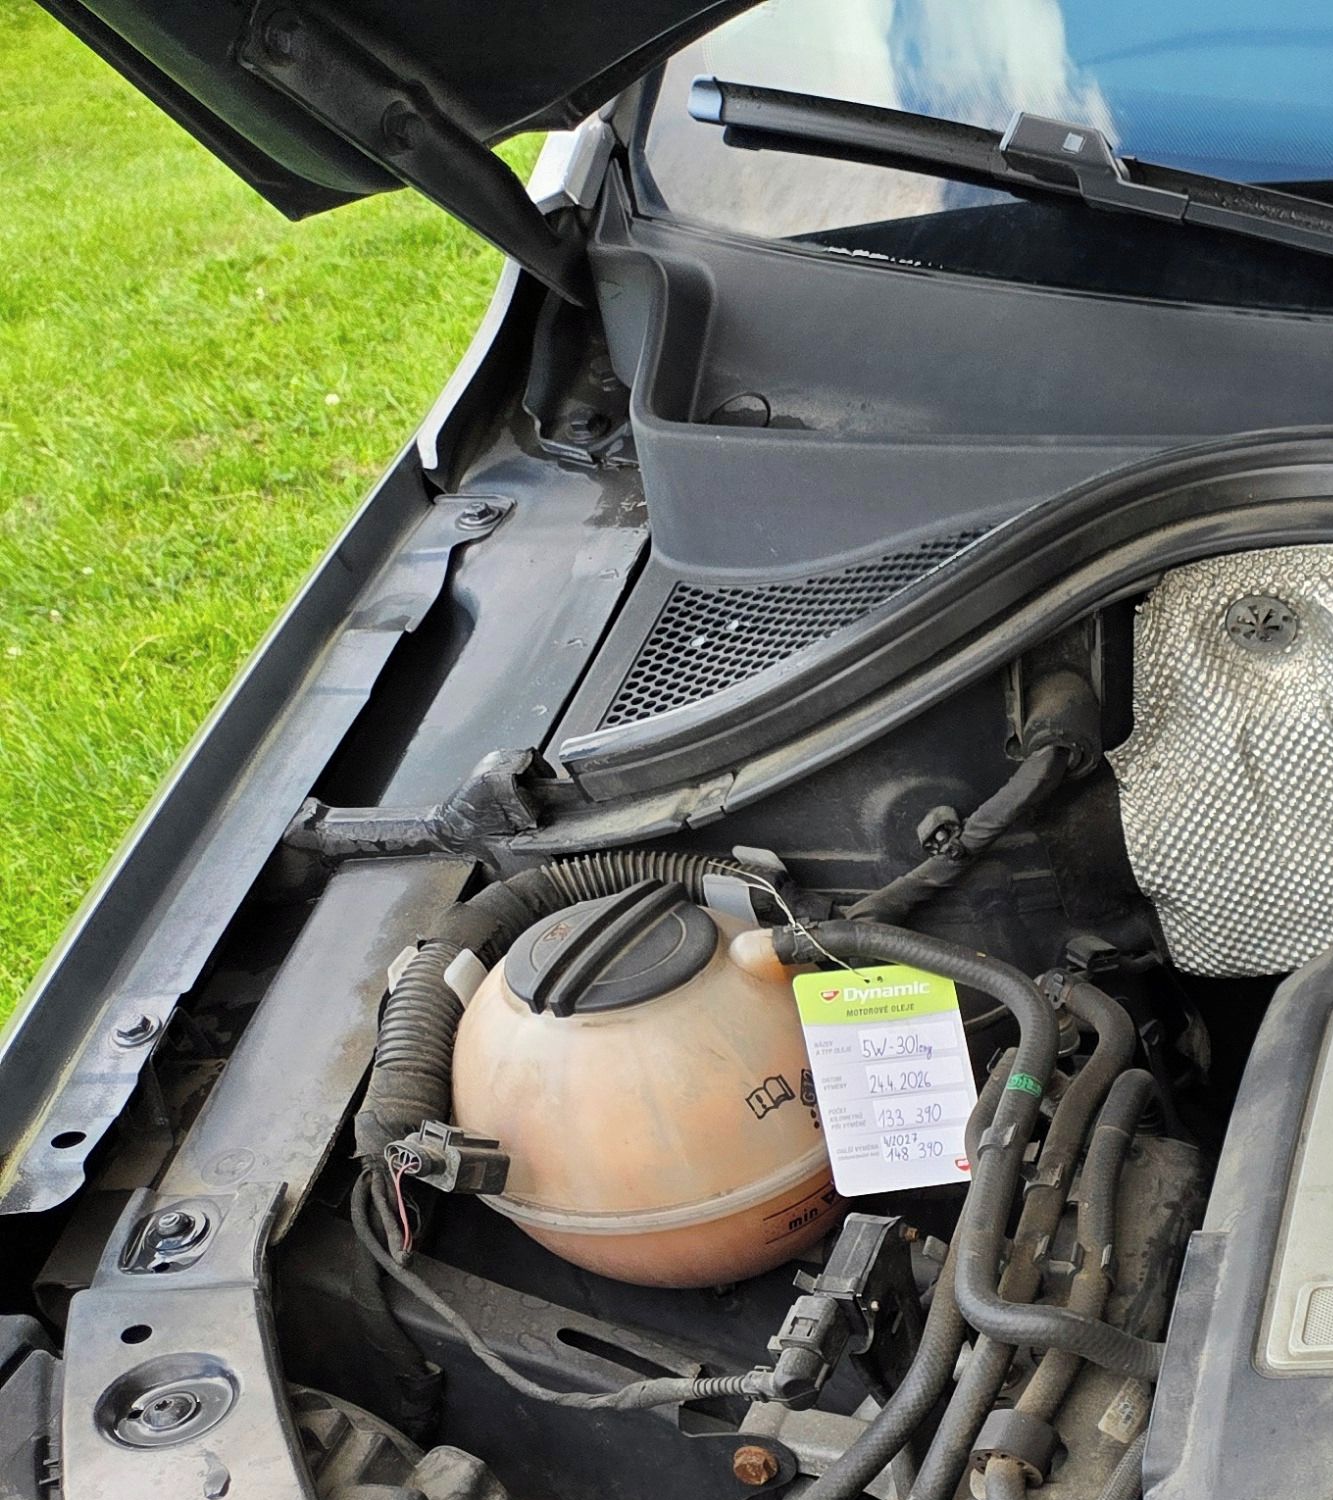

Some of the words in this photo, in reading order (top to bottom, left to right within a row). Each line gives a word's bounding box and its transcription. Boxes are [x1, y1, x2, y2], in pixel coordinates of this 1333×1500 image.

[843, 982, 930, 1004] Dynamic
[847, 1005, 888, 1017] MOTOROVÉ
[891, 1003, 915, 1013] OLEJE
[879, 1109, 905, 1128] 133
[915, 1103, 942, 1124] 390
[887, 1147, 909, 1162] 148
[918, 1141, 944, 1159] 390
[789, 1208, 818, 1230] min
